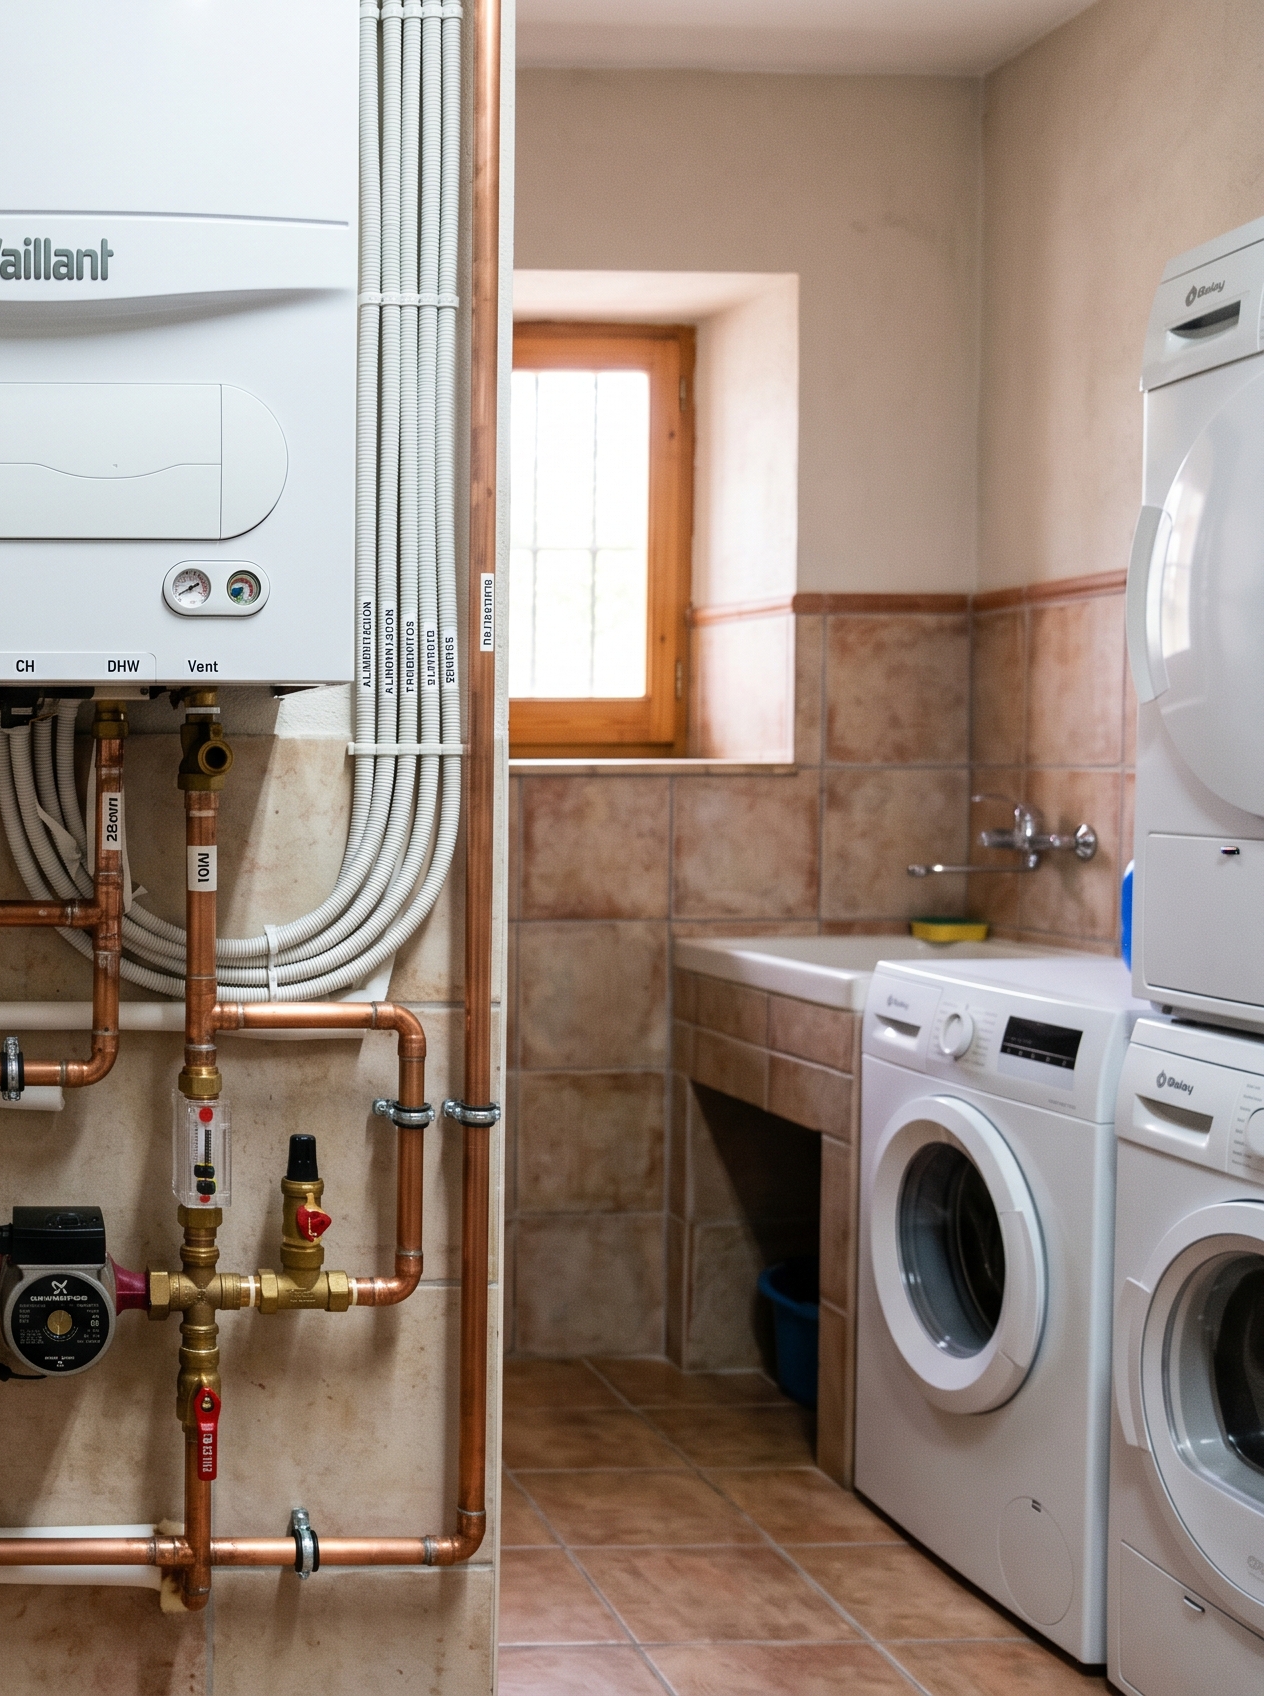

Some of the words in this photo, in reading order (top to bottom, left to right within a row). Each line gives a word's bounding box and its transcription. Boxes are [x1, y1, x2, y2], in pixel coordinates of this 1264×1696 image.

[15, 659, 35, 673] CH
[107, 659, 140, 673] DHW
[187, 659, 219, 673] Vent
